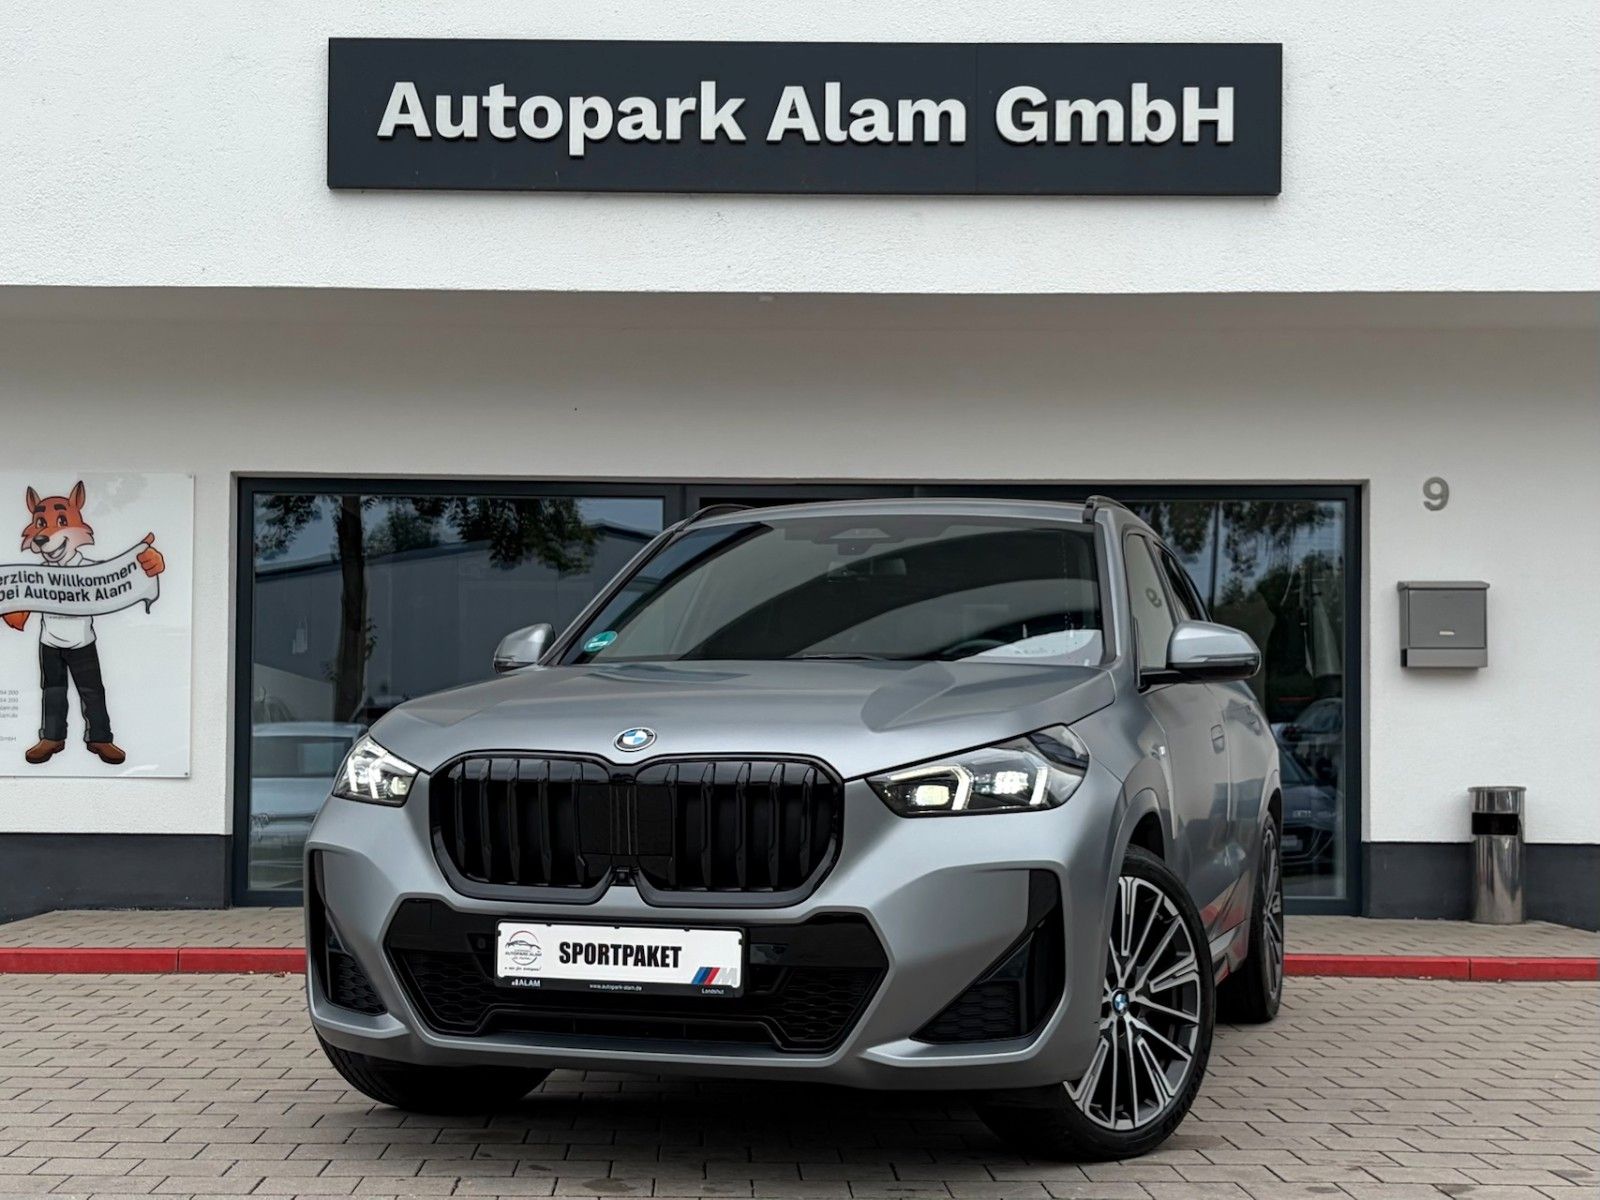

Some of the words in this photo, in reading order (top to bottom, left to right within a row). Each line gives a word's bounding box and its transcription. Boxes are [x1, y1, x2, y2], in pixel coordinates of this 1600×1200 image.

[377, 80, 747, 158] Autopark
[766, 81, 967, 145] Alam
[995, 82, 1236, 145] GmbH
[1422, 476, 1450, 512] 9
[47, 561, 138, 588] Willkommen
[24, 585, 91, 603] Autopark
[95, 581, 133, 601] Alam
[558, 941, 682, 969] SPORTPAKET
[518, 978, 541, 987] ALAM
